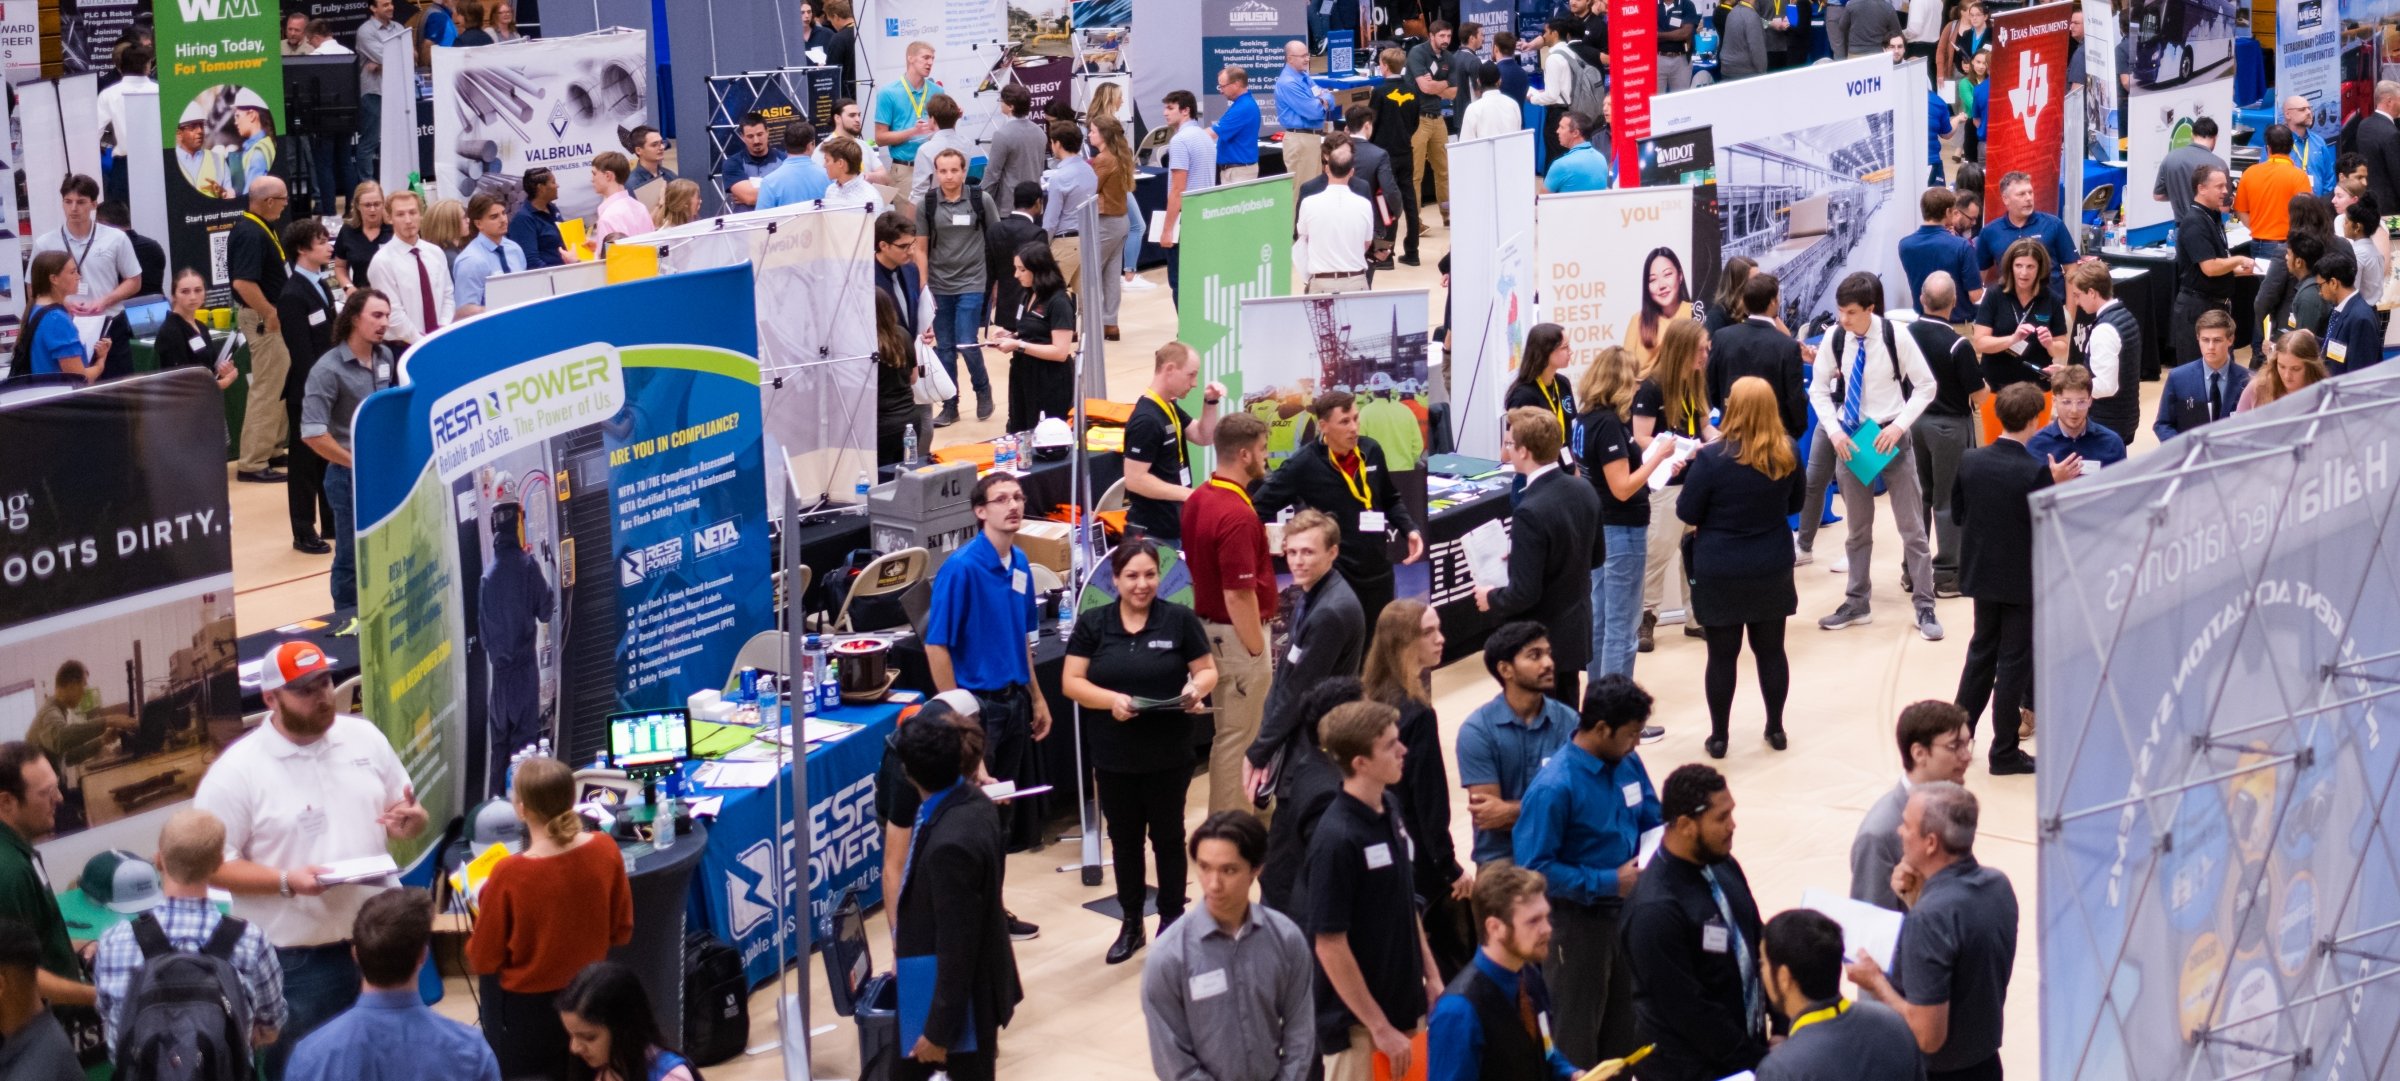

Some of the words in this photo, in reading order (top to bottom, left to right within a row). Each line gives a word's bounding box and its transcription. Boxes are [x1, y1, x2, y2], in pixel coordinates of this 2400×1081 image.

[83, 18, 134, 26] Programming
[1229, 11, 1278, 22] WAUSAU
[175, 42, 217, 57] Hiring
[221, 37, 265, 53] Today,
[1214, 47, 1263, 55] Manufacturing
[1223, 54, 1255, 62] Industrial
[174, 62, 197, 76] For
[1026, 81, 1062, 93] NERGY
[1846, 76, 1881, 97] VOITH
[525, 142, 593, 162] VALBRUNA
[1662, 143, 1695, 163] MDOT
[185, 214, 203, 223] Start
[204, 212, 220, 222] your
[220, 210, 245, 219] tomorr
[1620, 206, 1660, 228] you
[1552, 261, 1581, 280] DO
[1553, 281, 1607, 301] YOUR
[1553, 303, 1603, 322] BEST
[1566, 324, 1615, 344] ORK
[433, 397, 482, 449] RESA
[504, 355, 611, 412] POWER
[439, 439, 469, 476] Reliable
[470, 434, 487, 456] and
[514, 415, 535, 437] The
[537, 402, 574, 429] Power
[577, 397, 592, 416] of
[610, 446, 631, 468] ARE
[633, 439, 655, 460] YOU
[658, 434, 670, 453] IN
[671, 411, 740, 448] COMPLIANCE?
[618, 483, 635, 499] NFPA
[661, 466, 699, 484] Compliance
[700, 452, 735, 472] Assessment
[619, 500, 637, 515] NETA
[637, 491, 666, 509] Certified
[667, 484, 691, 501] Testing
[692, 479, 697, 491] &
[698, 469, 736, 490] Maintenance
[621, 518, 633, 531] Arc
[633, 511, 651, 527] Flash
[652, 504, 673, 521] Safety
[673, 497, 700, 514] Training
[116, 508, 222, 557] DIRTY.
[645, 536, 682, 562] RESA
[694, 520, 739, 553] NETA
[646, 551, 682, 572] POWER
[638, 603, 648, 613] Arc
[648, 596, 663, 610] Flash
[668, 589, 685, 602] Shock
[685, 583, 704, 597] Hazard
[638, 618, 648, 628] Arc
[648, 611, 664, 624] Flash
[669, 604, 686, 617] Shock
[686, 598, 705, 611] Hazard
[705, 592, 722, 605] Labels
[638, 630, 658, 643] Review
[658, 626, 664, 636] of
[665, 615, 697, 633] Engineering
[697, 603, 736, 622] Documentation
[639, 641, 663, 657] Personal
[663, 632, 692, 648] Protective
[692, 622, 721, 640] Equipment
[720, 616, 736, 631] (PPE)
[669, 643, 704, 661] Maintenance
[639, 672, 657, 687] Safety
[658, 665, 682, 679] Training
